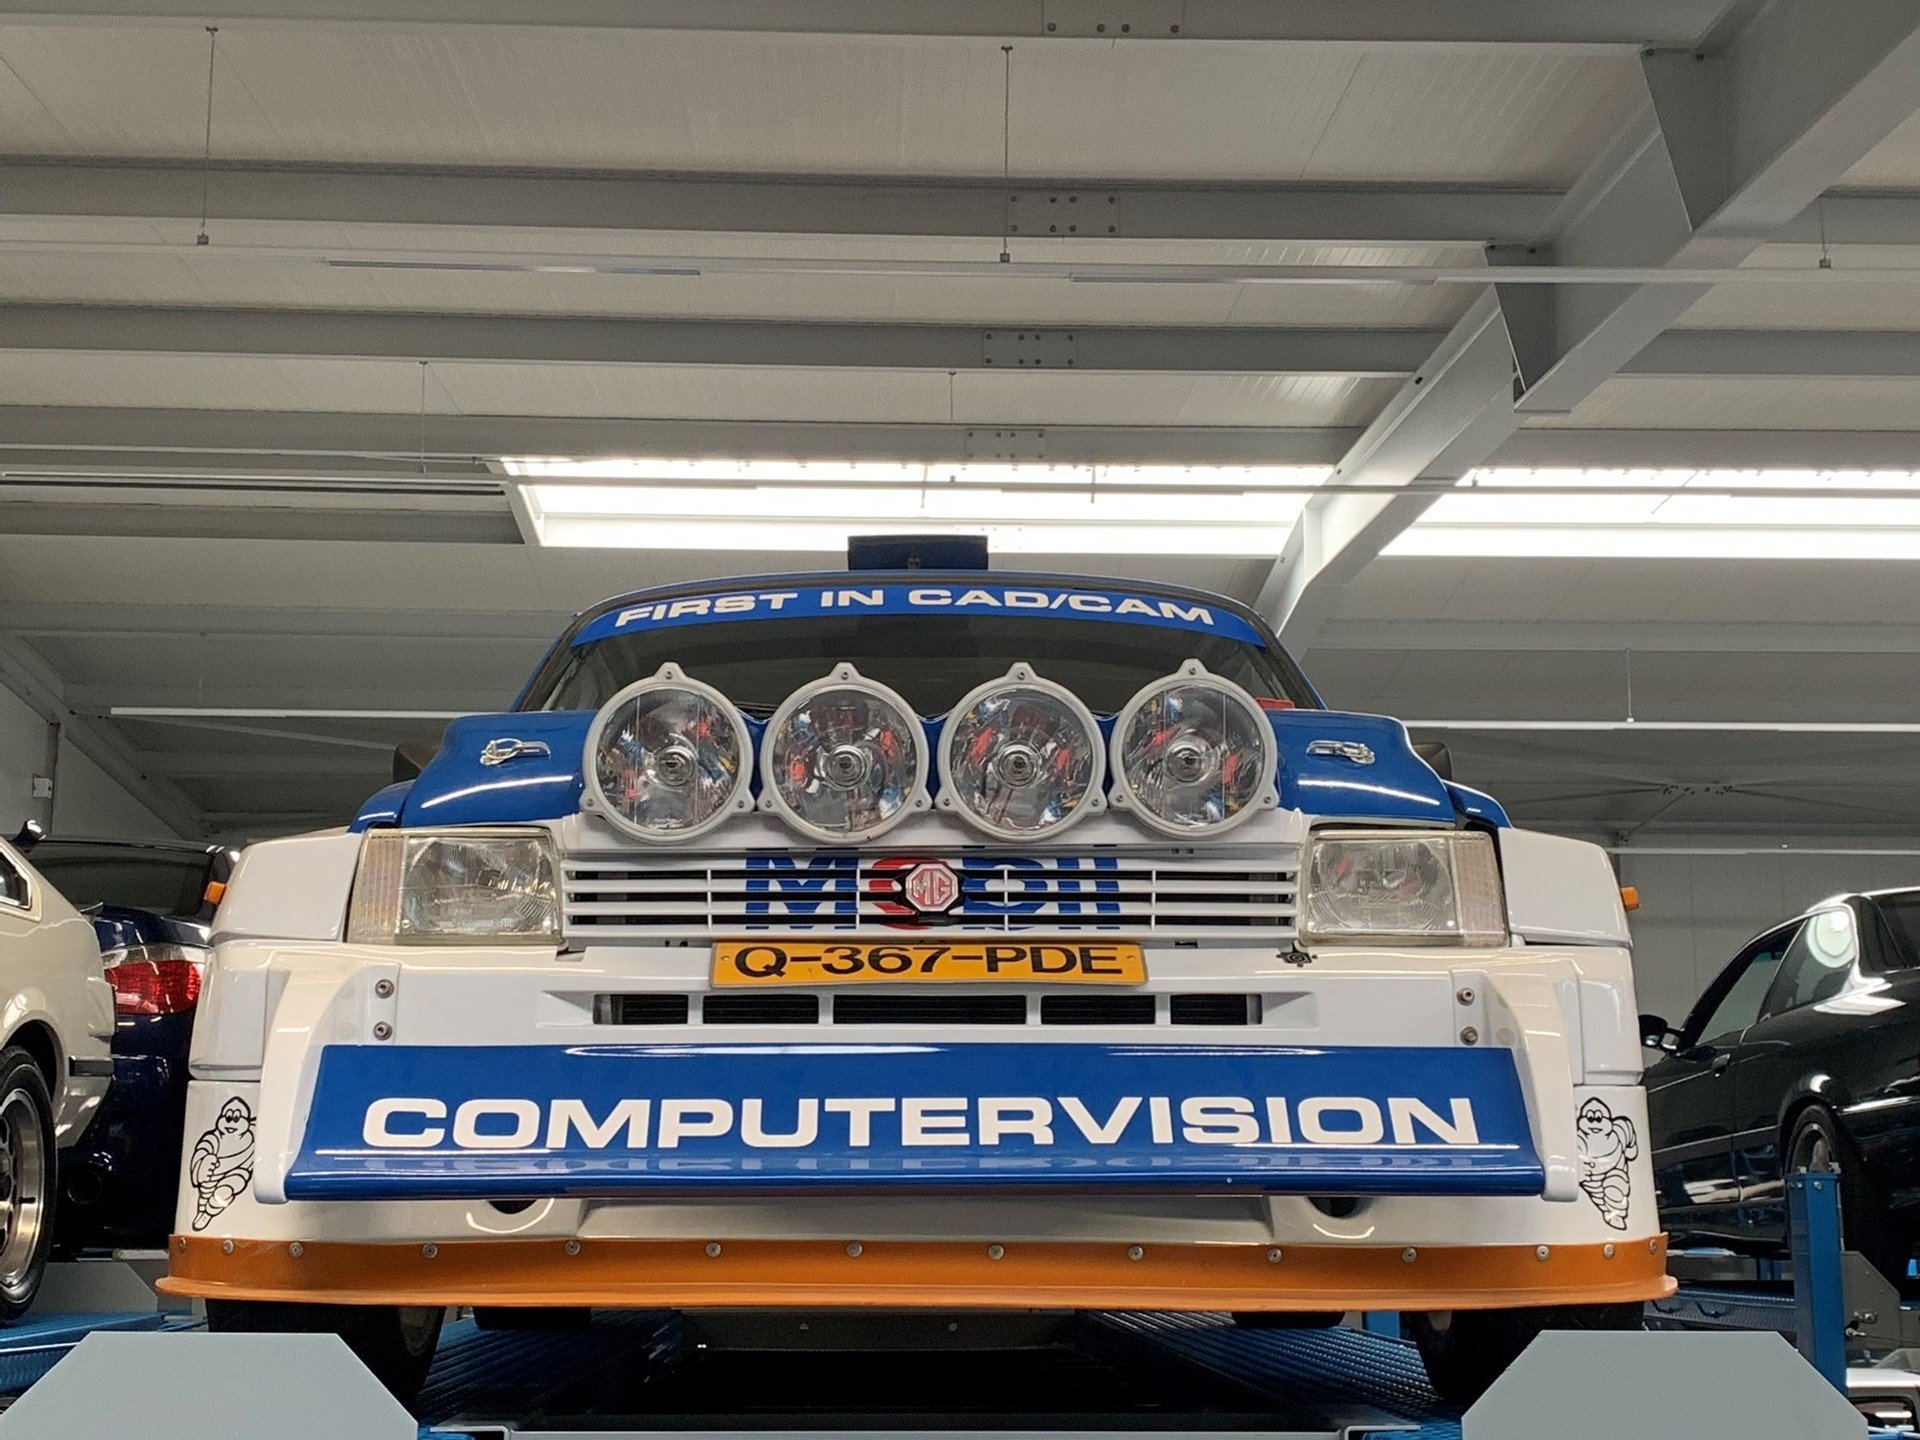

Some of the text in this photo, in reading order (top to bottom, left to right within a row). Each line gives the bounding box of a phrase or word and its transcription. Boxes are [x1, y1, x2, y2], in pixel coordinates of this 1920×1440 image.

[615, 589, 1214, 628] FIRST IN CAD/CAM
[912, 870, 951, 905] MG
[734, 945, 1123, 978] Q-367-PDE
[362, 1096, 1480, 1150] COMPUTERVISION
